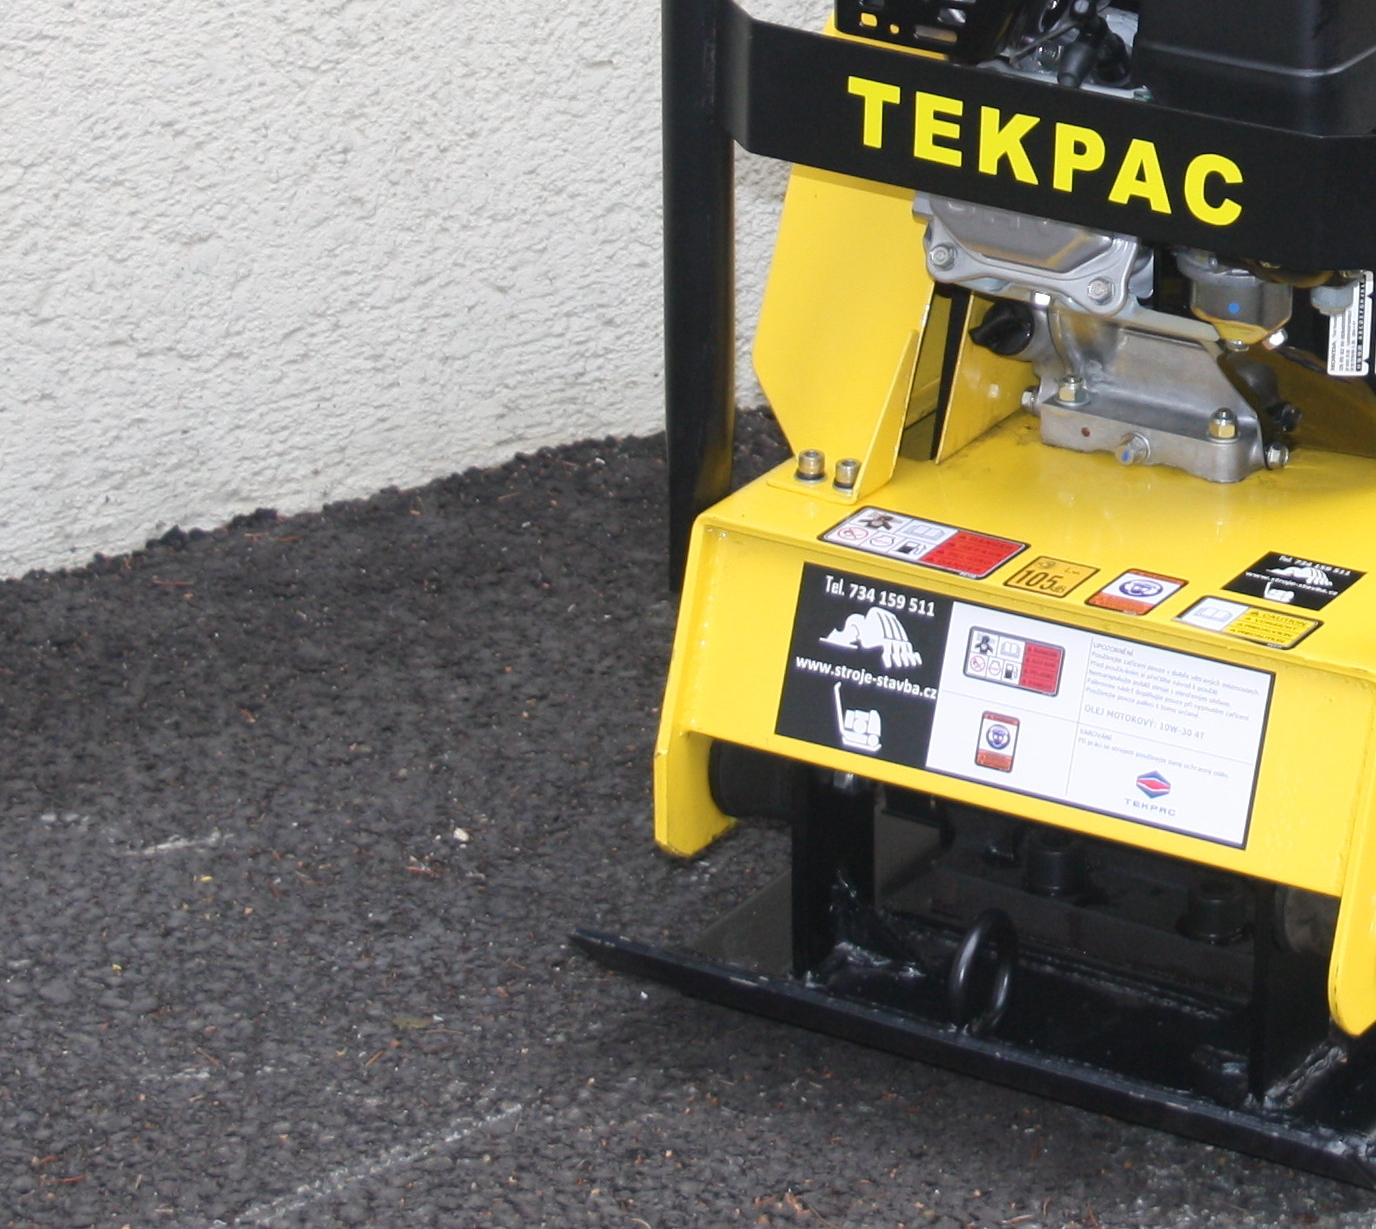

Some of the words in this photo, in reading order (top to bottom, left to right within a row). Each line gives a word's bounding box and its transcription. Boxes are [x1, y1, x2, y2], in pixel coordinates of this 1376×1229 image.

[847, 75, 1243, 227] TEKPAC
[825, 575, 845, 596] Tel.
[849, 583, 876, 603] 734
[879, 590, 906, 610] 159
[908, 598, 935, 617] 511
[1015, 569, 1063, 592] 105
[796, 656, 938, 700] www.stroje-stavba.cz
[1084, 704, 1104, 715] OLEJ
[1159, 722, 1192, 737] 10W-30
[1124, 798, 1176, 817] TEKPAC
